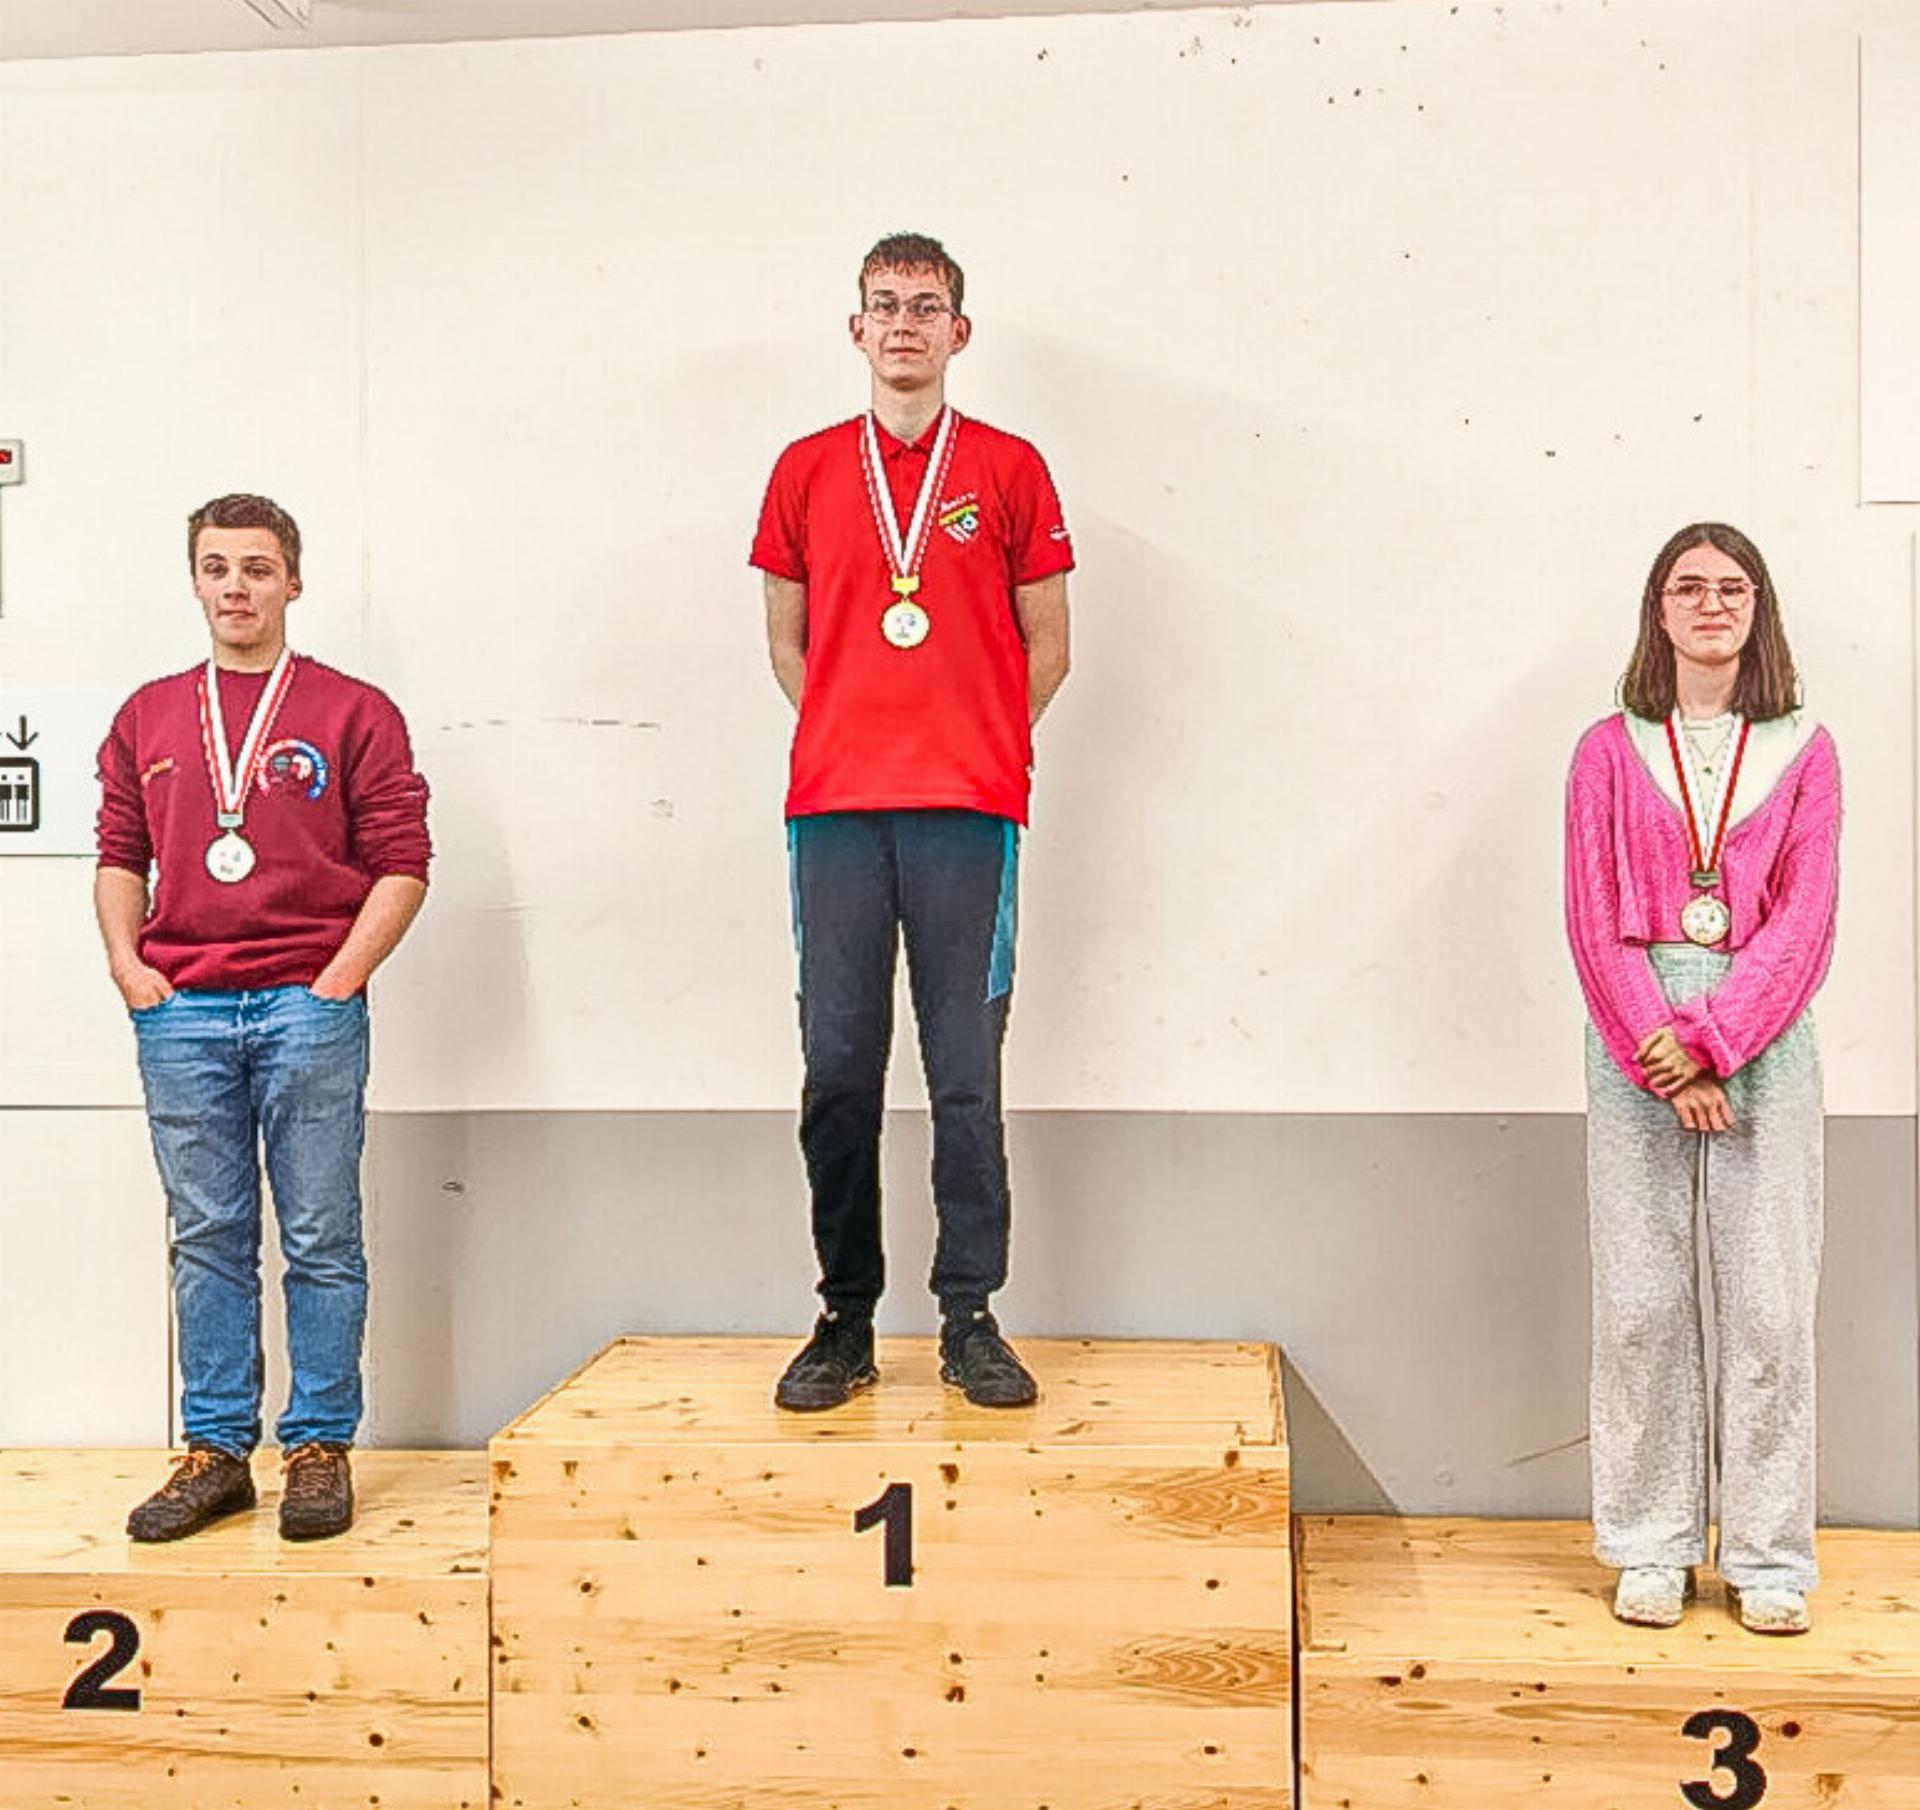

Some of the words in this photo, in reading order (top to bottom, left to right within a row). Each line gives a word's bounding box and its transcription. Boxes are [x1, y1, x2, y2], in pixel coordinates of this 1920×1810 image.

[854, 1483, 913, 1587] 1
[62, 1610, 141, 1711] 2
[1680, 1709, 1767, 1810] 3
